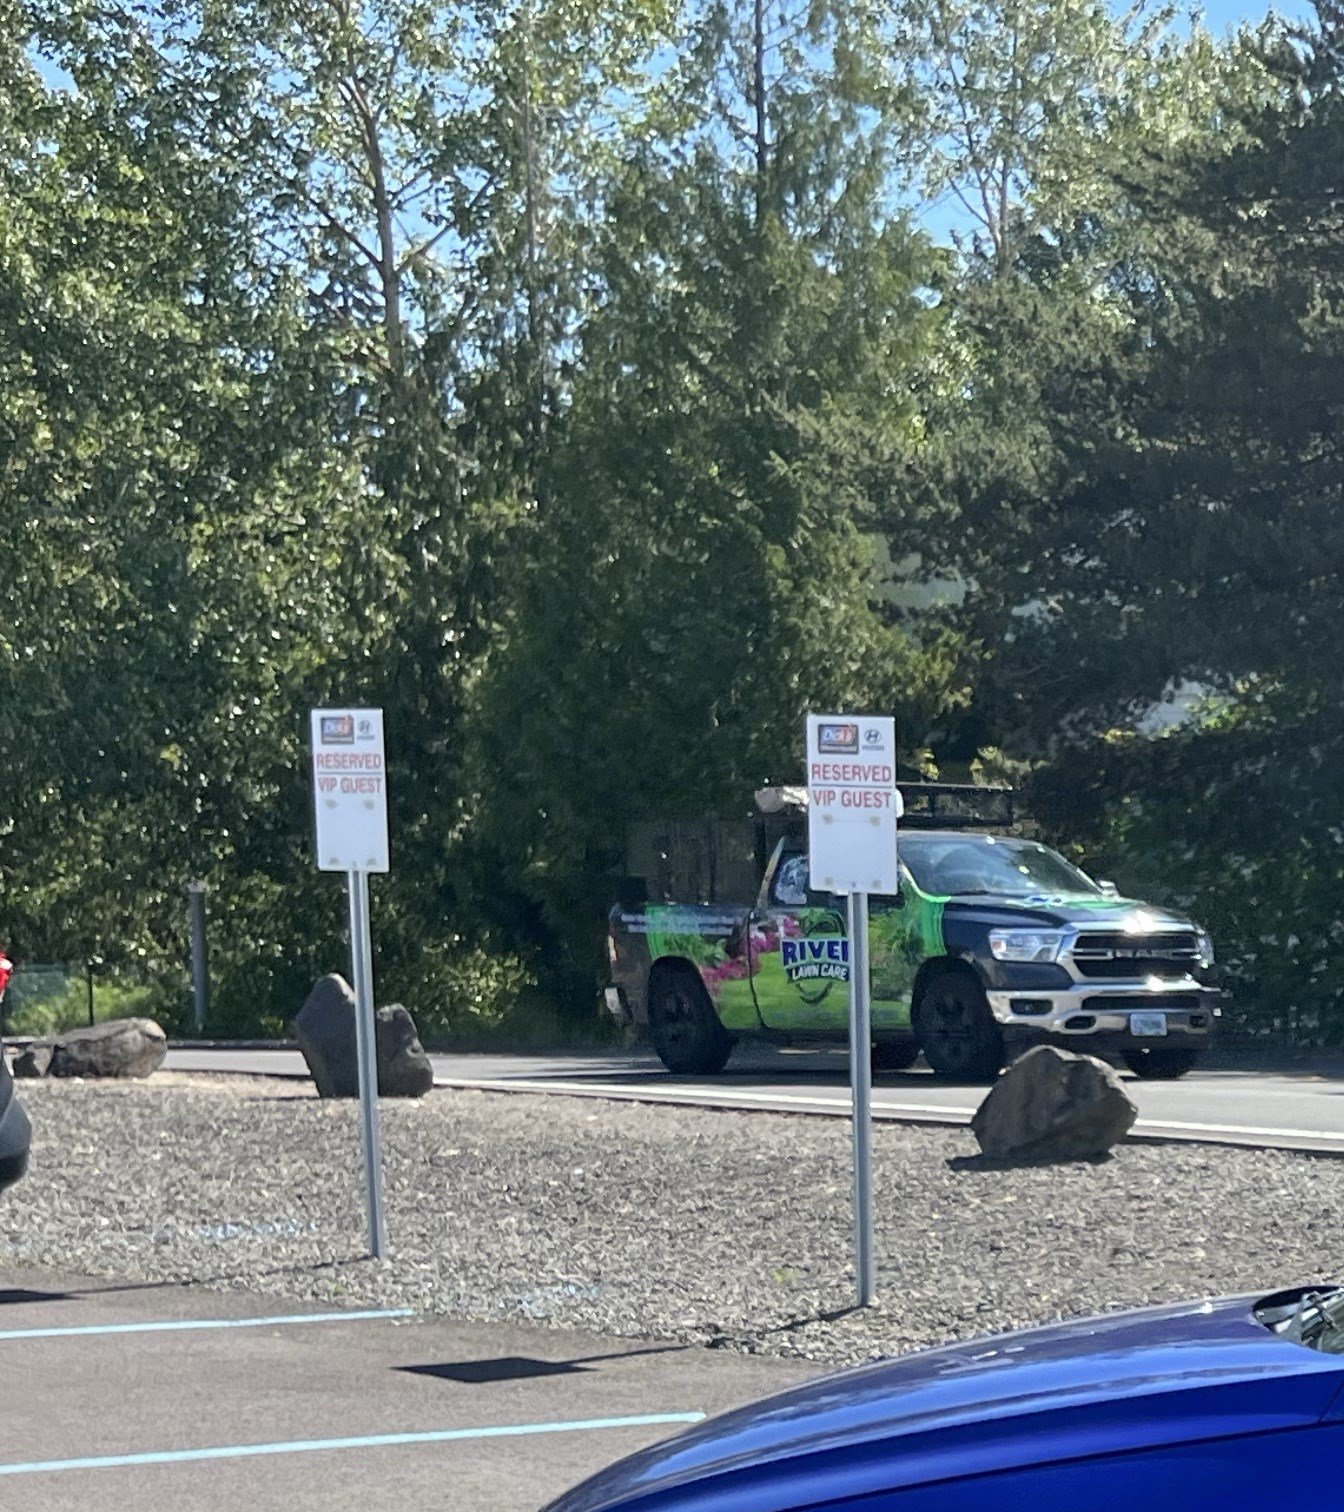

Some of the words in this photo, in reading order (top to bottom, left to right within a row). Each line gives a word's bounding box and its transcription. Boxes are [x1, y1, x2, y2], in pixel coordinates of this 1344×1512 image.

[317, 753, 381, 769] RESERVED
[812, 764, 891, 781] RESERVED
[319, 778, 338, 792] VIP
[341, 778, 381, 793] GUEST
[813, 790, 836, 806] VIP
[842, 791, 891, 808] GUEST
